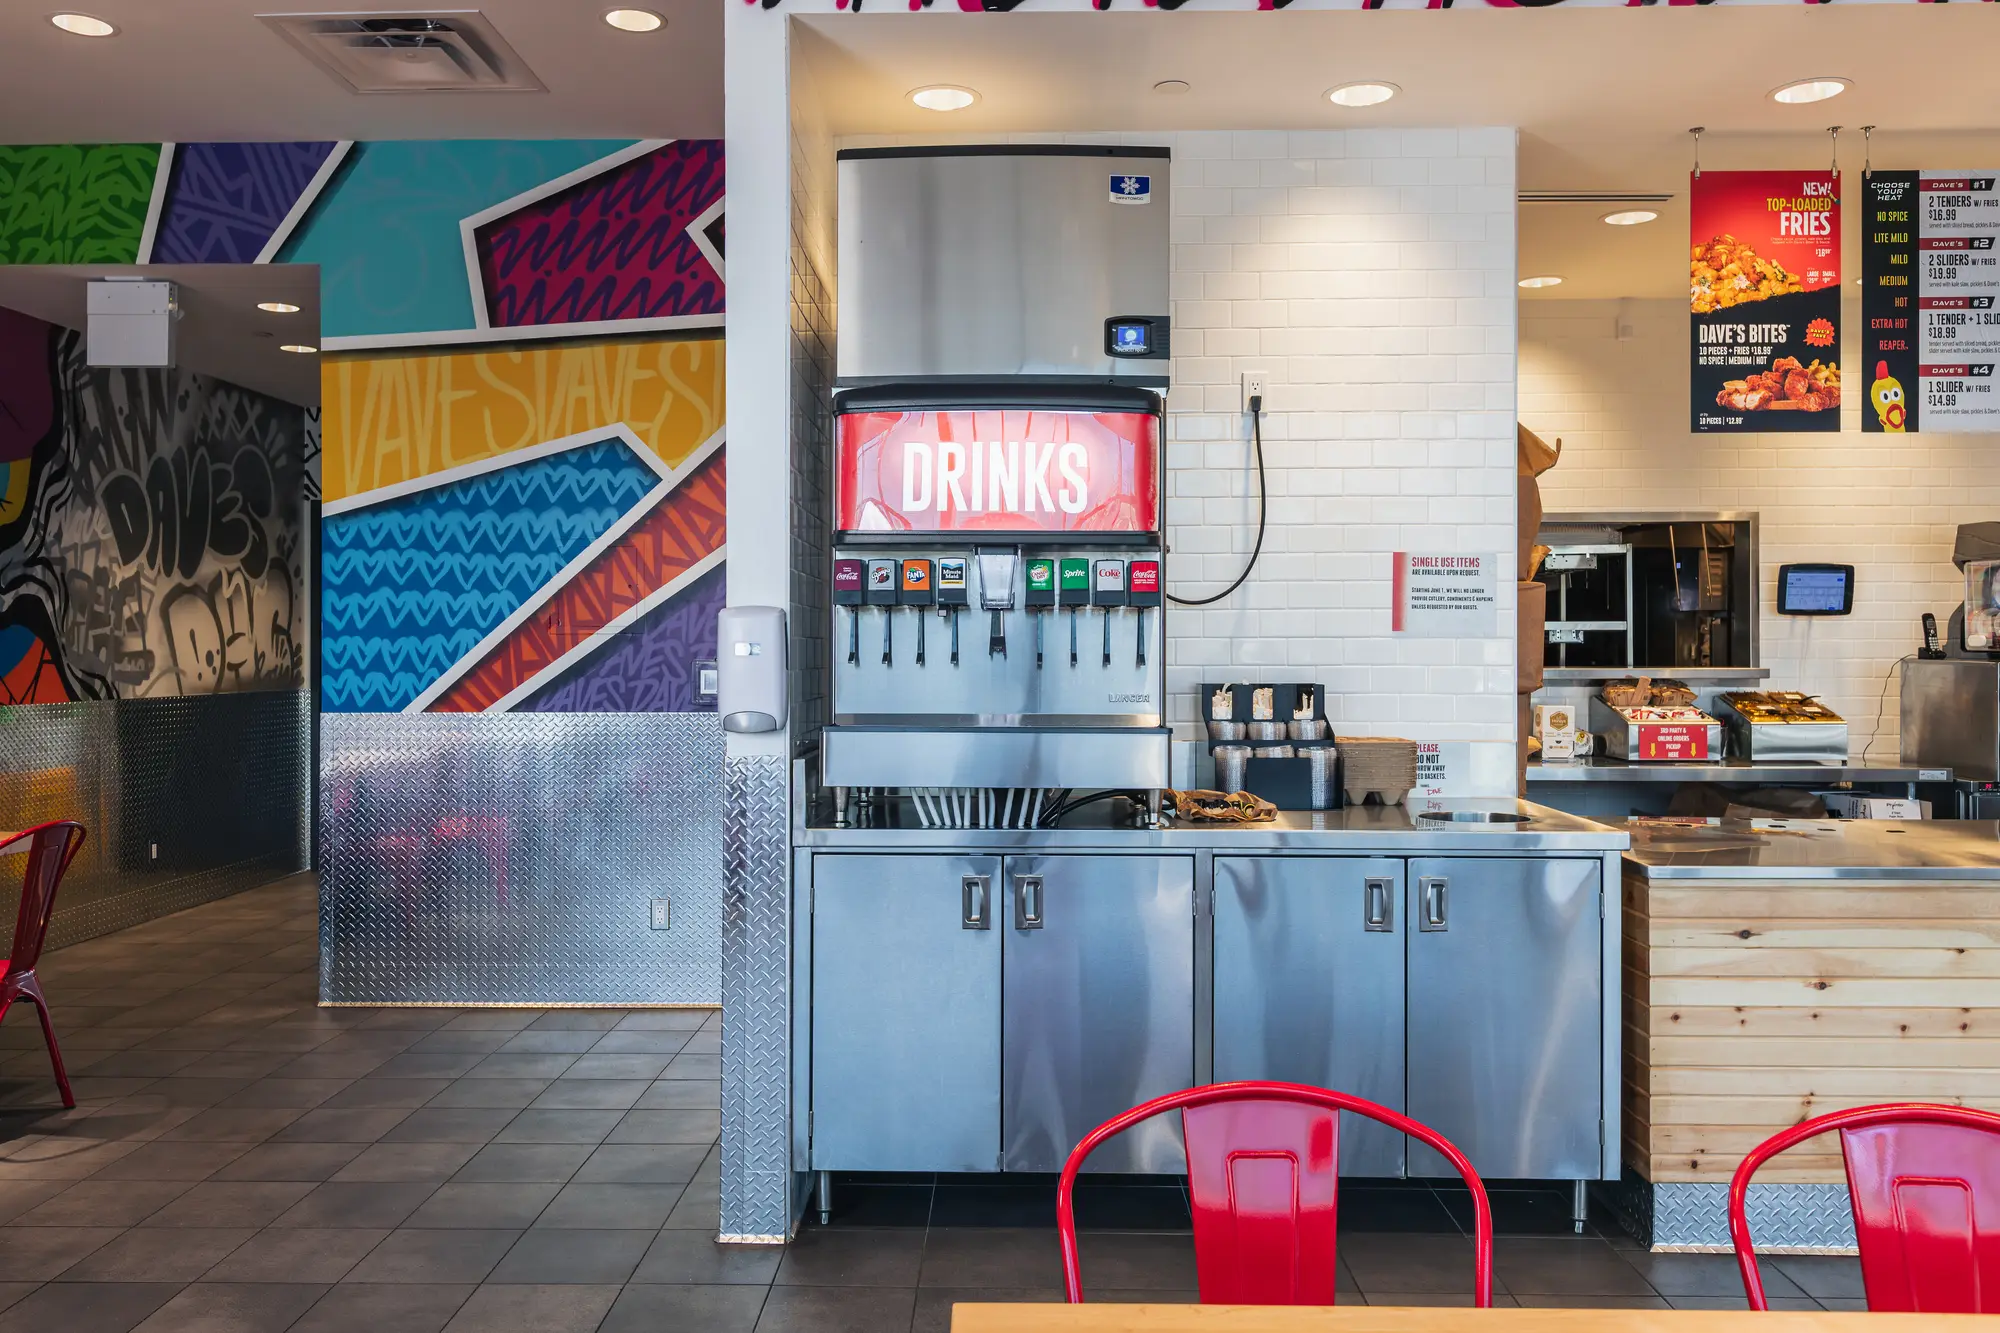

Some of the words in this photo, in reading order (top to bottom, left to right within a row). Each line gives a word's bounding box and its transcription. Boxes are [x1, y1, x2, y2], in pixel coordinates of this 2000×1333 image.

[1803, 182, 1831, 196] NEW!
[1973, 180, 1986, 189] #1
[1767, 198, 1831, 211] TOP-LOADED
[1929, 196, 1934, 207] 2
[1937, 196, 1972, 207] TENDERS
[1877, 212, 1886, 221] NO
[1888, 212, 1908, 221] SPICE
[1929, 209, 1956, 220] $16.99
[1780, 212, 1831, 236] FRIES
[1874, 233, 1888, 243] LITE
[1891, 233, 1908, 243] MILD
[1973, 239, 1989, 248] #2
[1891, 254, 1908, 264] MILD
[1929, 254, 1934, 266] 2
[1937, 254, 1969, 266] SLIDERS
[1929, 267, 1956, 279] $19.99
[1880, 276, 1908, 286] MEDIUM
[1895, 297, 1908, 307] HOT
[1973, 298, 1988, 307] #3
[1872, 319, 1893, 329] EXTRA
[1895, 319, 1908, 328] HOT
[1929, 314, 1933, 325] 1
[1937, 314, 1966, 325] TENDER
[1976, 313, 1981, 325] 1
[1700, 324, 1745, 344] DAVE'S
[1749, 324, 1787, 343] BITES
[1929, 327, 1956, 338] $18.99
[1699, 347, 1707, 355] 10
[1708, 347, 1728, 355] PIECES
[1734, 346, 1750, 355] FRIES
[1699, 356, 1707, 365] NO
[1708, 356, 1724, 365] SPICE
[1729, 356, 1752, 364] MEDIUM
[1756, 356, 1767, 364] HOT
[1973, 366, 1989, 374] #4
[1929, 382, 1933, 392] 1
[1936, 381, 1964, 392] SLIDER
[1928, 395, 1956, 406] $14.99
[903, 441, 1088, 514] DRINKS
[96, 445, 275, 580] DAVES
[1412, 557, 1439, 567] SINGLE
[1441, 557, 1455, 567] USE
[1456, 558, 1480, 567] ITEMS
[1064, 570, 1085, 579] Sprite
[1099, 569, 1120, 577] Coke
[1108, 693, 1150, 703] LANCER
[1426, 755, 1440, 763] NOT
